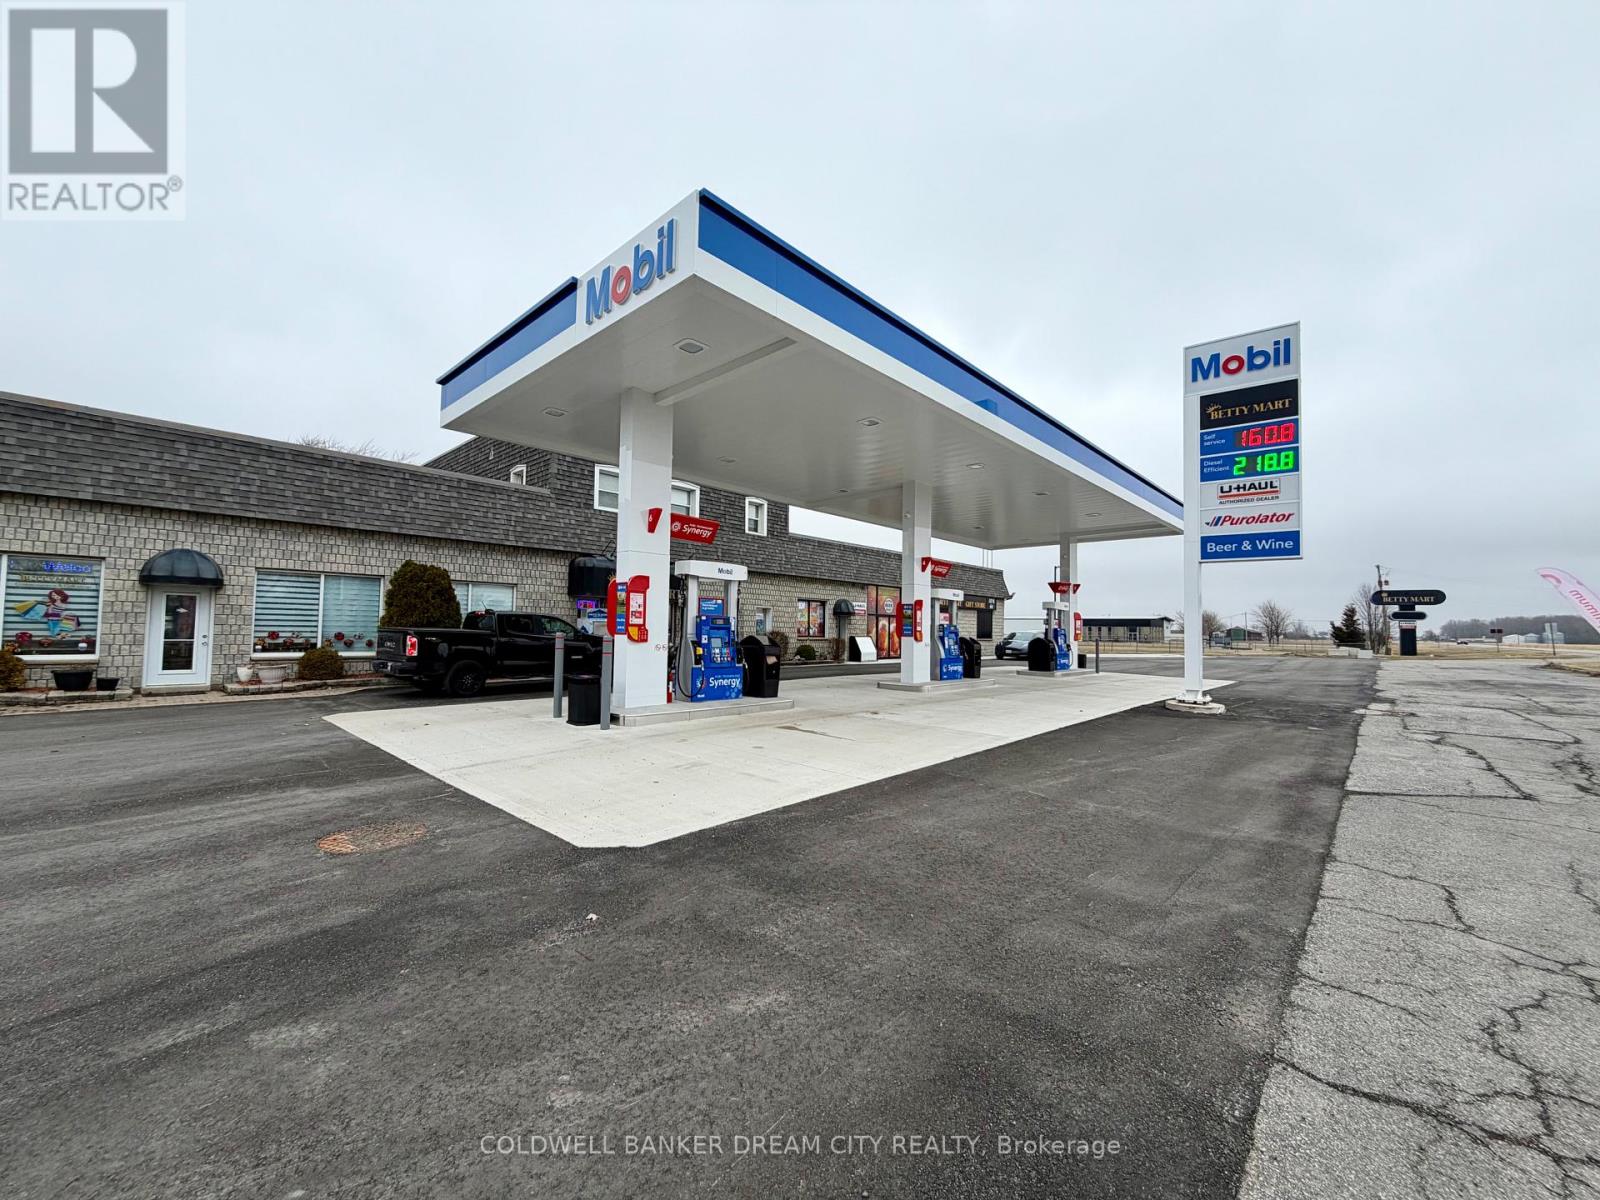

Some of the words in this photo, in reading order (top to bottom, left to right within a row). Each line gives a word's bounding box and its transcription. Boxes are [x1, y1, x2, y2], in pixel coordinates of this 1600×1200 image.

[585, 217, 678, 326] Mobil
[1191, 337, 1291, 383] Mobil
[1209, 404, 1250, 420] BETTY
[1252, 398, 1293, 413] MART
[1203, 433, 1216, 441] Self
[1203, 439, 1226, 447] service
[1203, 459, 1223, 467] Diesel
[1203, 466, 1230, 474] Efficient
[1220, 480, 1278, 494] U-HAUL
[1219, 512, 1295, 527] Purolator
[682, 524, 712, 538] Synergy
[1206, 542, 1238, 553] Beer
[1241, 540, 1252, 551] &
[1256, 538, 1294, 550] Wine
[717, 567, 734, 576] Mobil
[709, 676, 741, 689] Synergy
